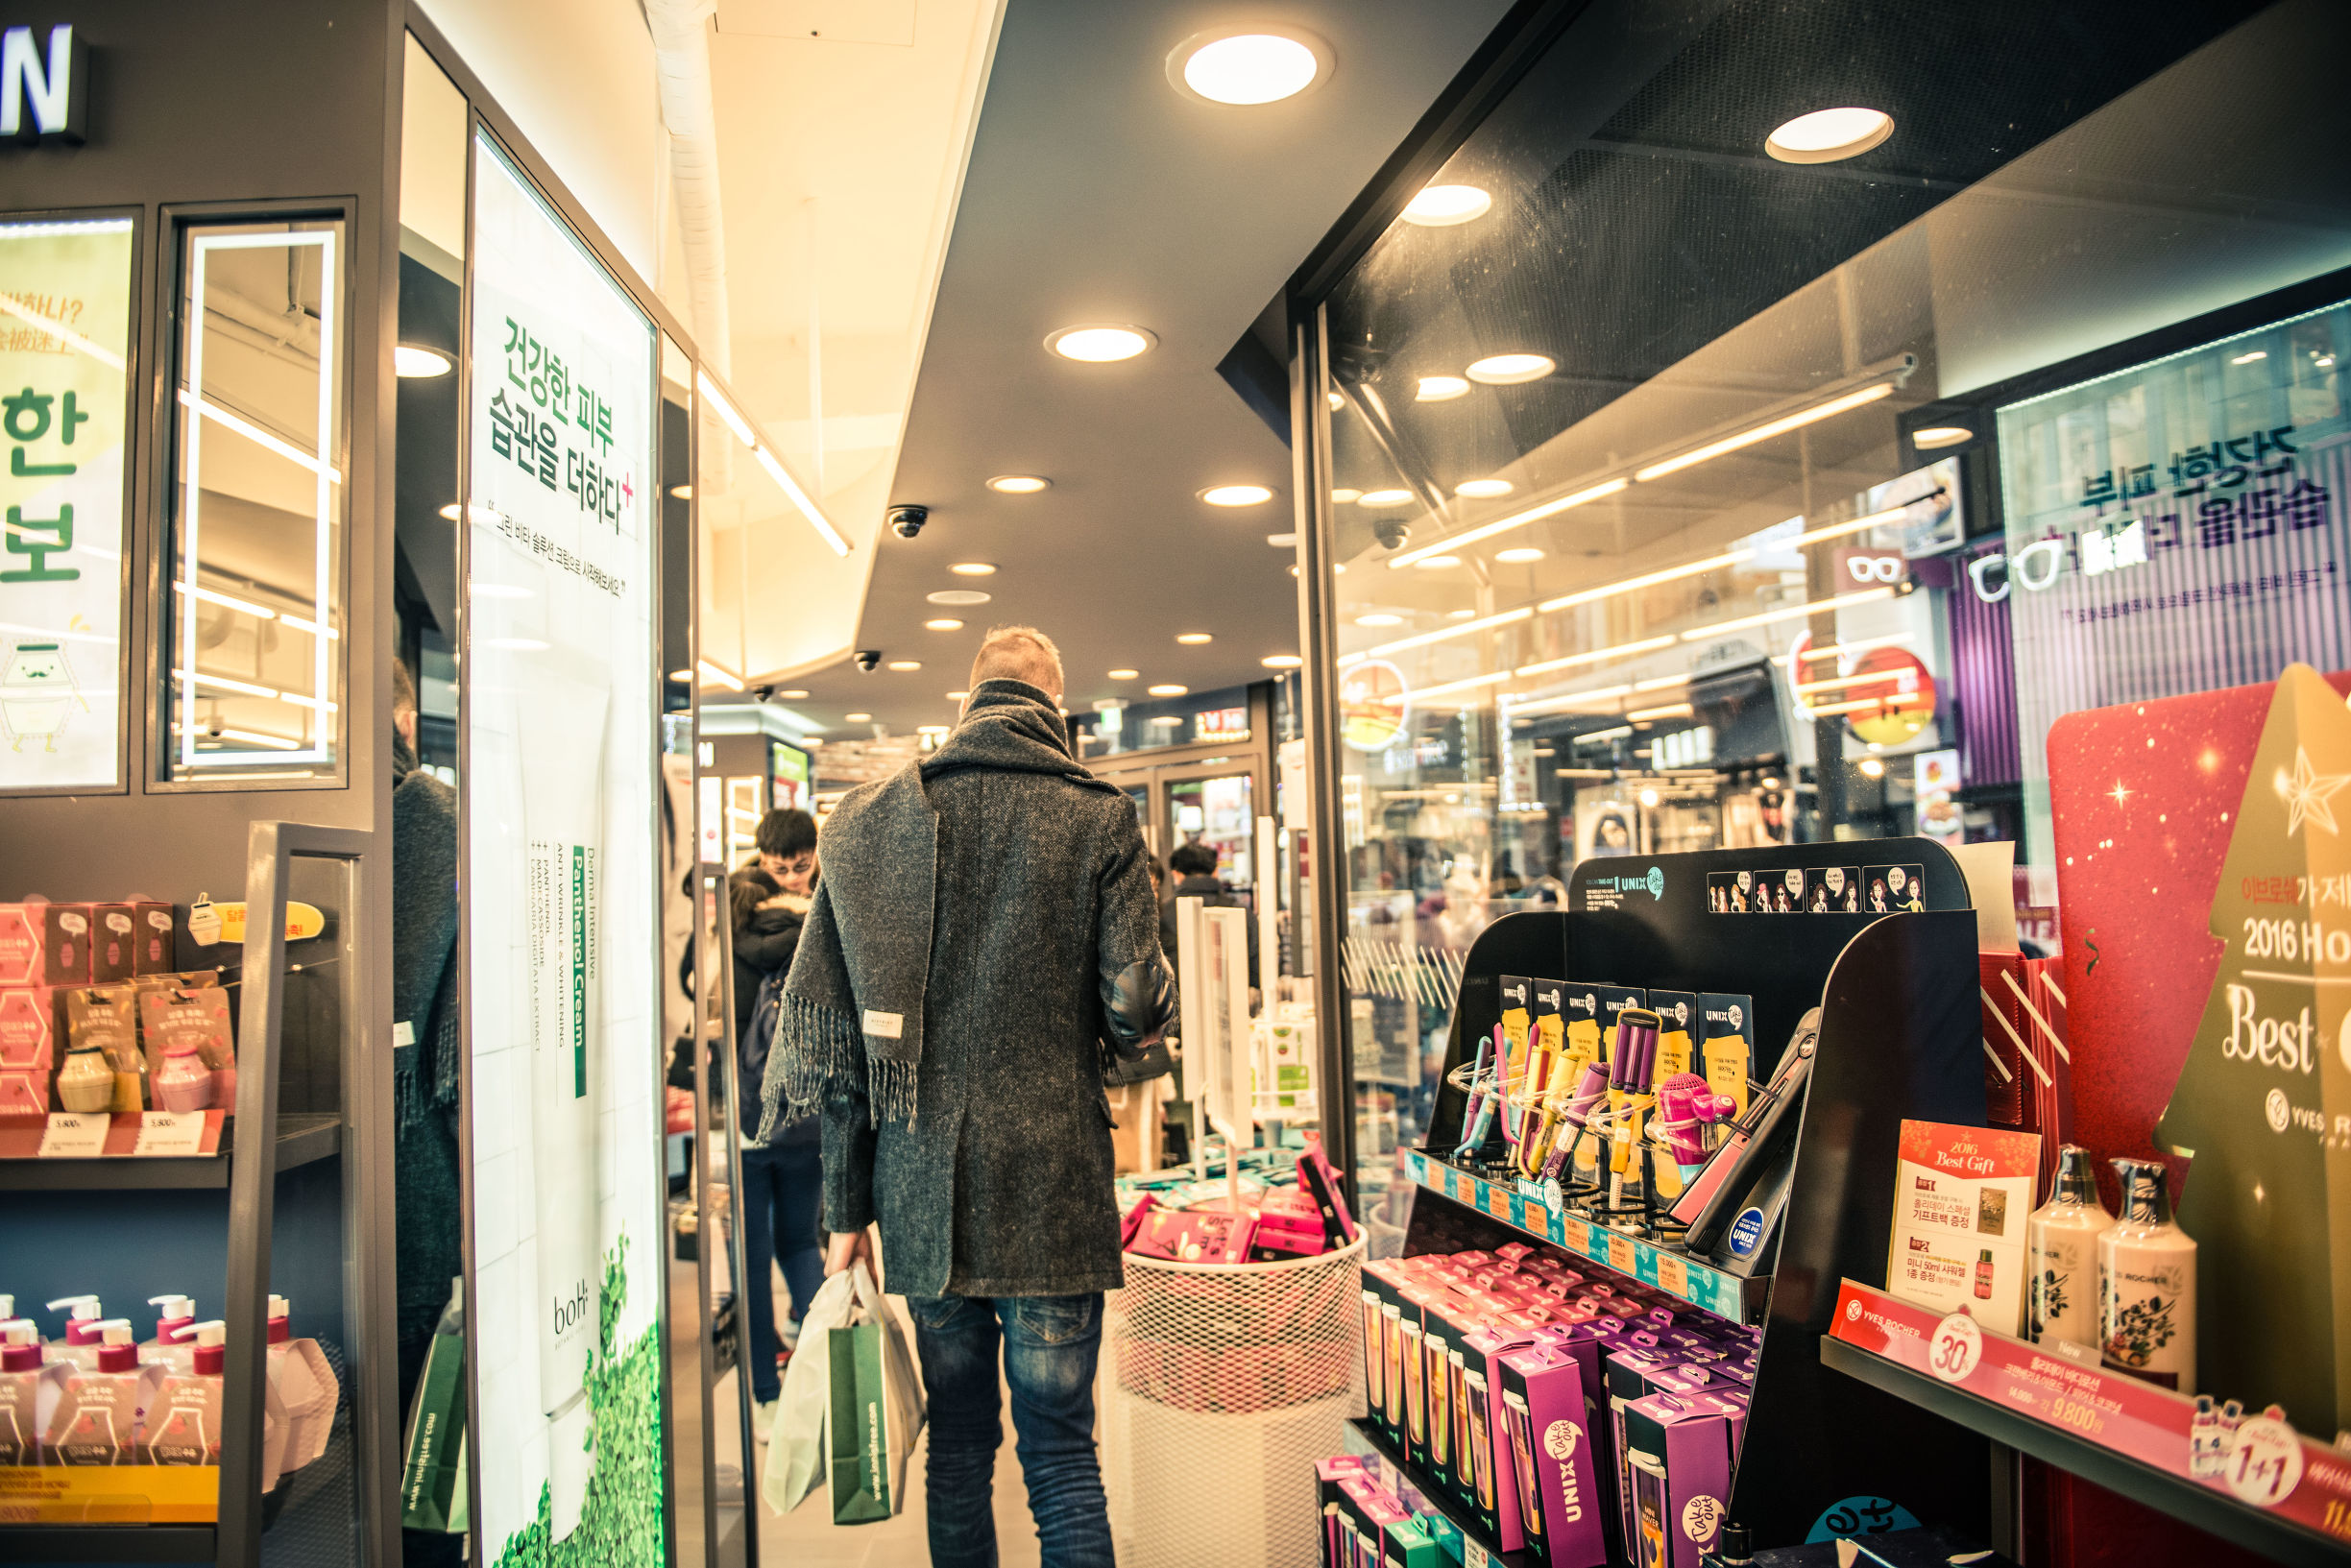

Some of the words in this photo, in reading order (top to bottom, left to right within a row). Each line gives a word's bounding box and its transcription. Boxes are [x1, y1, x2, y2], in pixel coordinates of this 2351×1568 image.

[504, 315, 571, 426] 건강한
[577, 383, 615, 458] 피부
[490, 387, 560, 493] 습관을
[515, 521, 531, 549] 비타
[532, 531, 554, 563] 솔루션
[556, 546, 581, 576] 크림으로
[587, 847, 595, 901] Derma
[1621, 877, 1647, 891] UNIX
[536, 858, 545, 968] MADECASSOSIDE
[573, 856, 584, 969] Panthenol
[2242, 917, 2298, 962] 2016
[574, 974, 584, 1047] Cream
[1569, 997, 1586, 1007] UNIX
[1606, 1001, 1626, 1011] UNIX
[1655, 1006, 1675, 1018] UNIX
[1706, 1010, 1728, 1022] UNIX
[2221, 982, 2315, 1075] Best
[2290, 1106, 2324, 1133] YVES
[1950, 1141, 1978, 1155] 2016
[1934, 1149, 1964, 1169] Best
[1967, 1155, 1995, 1175] Gift
[1517, 1178, 1544, 1202] UNIX
[1913, 1197, 1945, 1212] 홀리데이
[1946, 1204, 1971, 1217] 스페셜
[1913, 1209, 1949, 1225] 기프트백
[1951, 1215, 1970, 1229] 증정
[1733, 1228, 1757, 1244] UNIX
[1642, 1268, 1658, 1281] UNIX
[1686, 1267, 1703, 1280] UNIX
[1906, 1268, 1918, 1279] 1종
[1920, 1270, 1935, 1283] 증정
[1907, 1258, 1922, 1269] 미니
[1924, 1261, 1941, 1272] 50ml
[1942, 1264, 1966, 1278] 샤워젤
[1863, 1310, 1884, 1325] YVES
[1884, 1318, 1921, 1338] ROCHER
[2057, 1340, 2082, 1359] New
[1550, 1423, 1567, 1459] Take
[1560, 1420, 1572, 1441] out
[2235, 1443, 2288, 1497] 1+1
[1559, 1459, 1583, 1523] UNIX
[1701, 1496, 1714, 1520] out
[1688, 1499, 1709, 1542] Take
